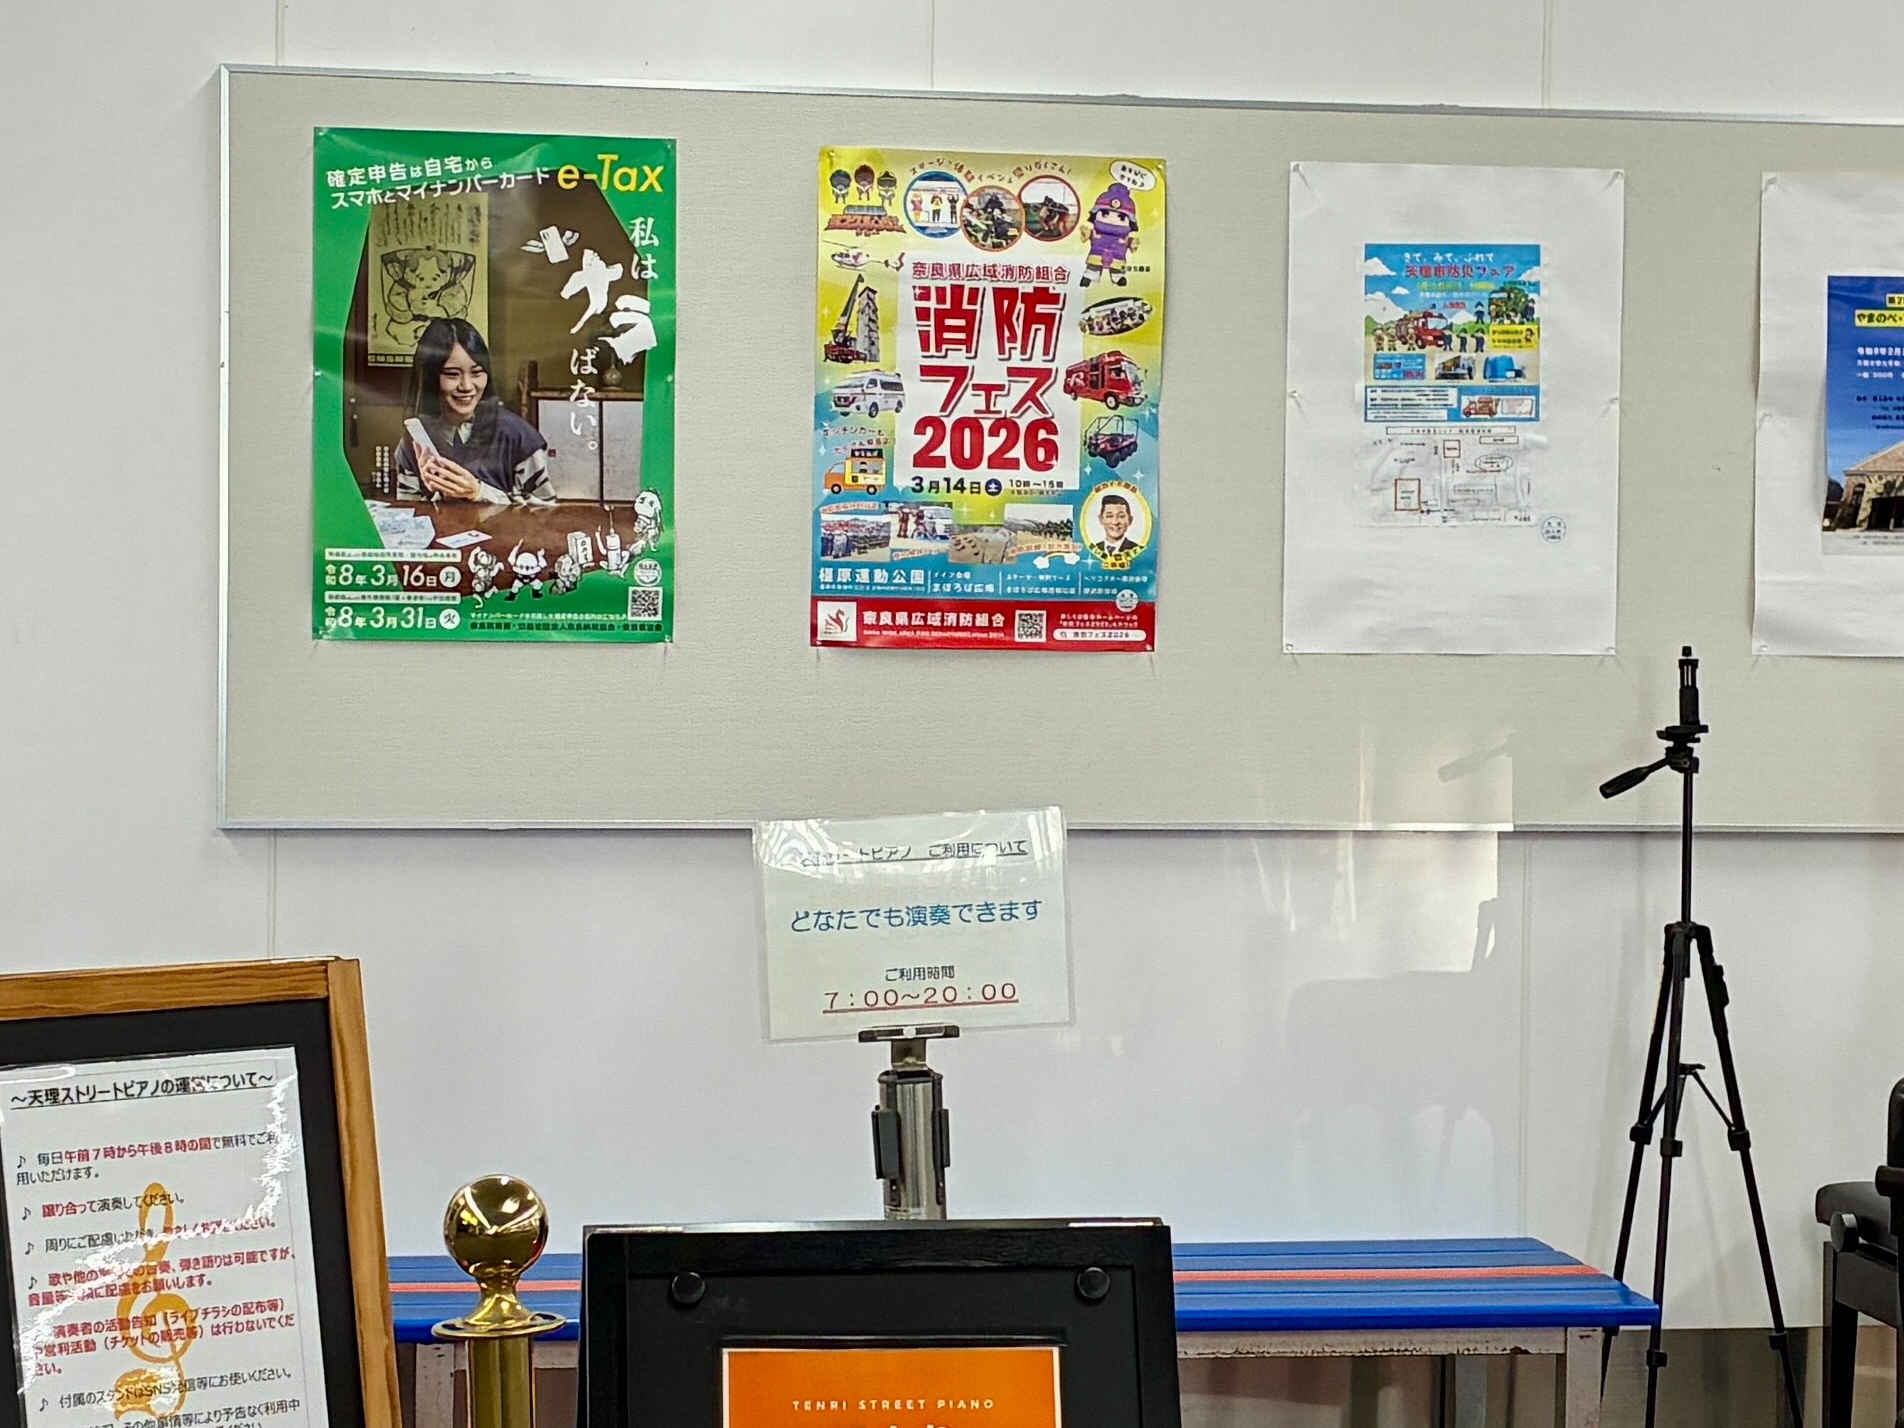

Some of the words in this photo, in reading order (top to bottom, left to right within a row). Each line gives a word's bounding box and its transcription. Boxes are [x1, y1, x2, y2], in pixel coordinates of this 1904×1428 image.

[326, 156, 494, 191] 確定申告は自宅から
[330, 167, 550, 210] スマホとマイナンバーカード
[557, 153, 665, 193] e-Tax
[629, 216, 660, 281] 私は
[912, 260, 1070, 283] 奈良県広域消防組合
[912, 283, 1069, 360] 消防
[569, 348, 600, 451] ばない。
[918, 365, 1060, 419] フェス
[912, 417, 1059, 472] 2026
[911, 475, 982, 495] 3月14日
[862, 610, 1006, 628] 奈良県広域消防組合
[790, 899, 1043, 933] どなたでも演奏できます
[884, 965, 955, 982] ご利用時間
[16, 1166, 100, 1186] 用いただけます。
[792, 1400, 847, 1411] TENRI
[858, 1399, 926, 1410] STREET
[937, 1398, 994, 1410] PIANO
